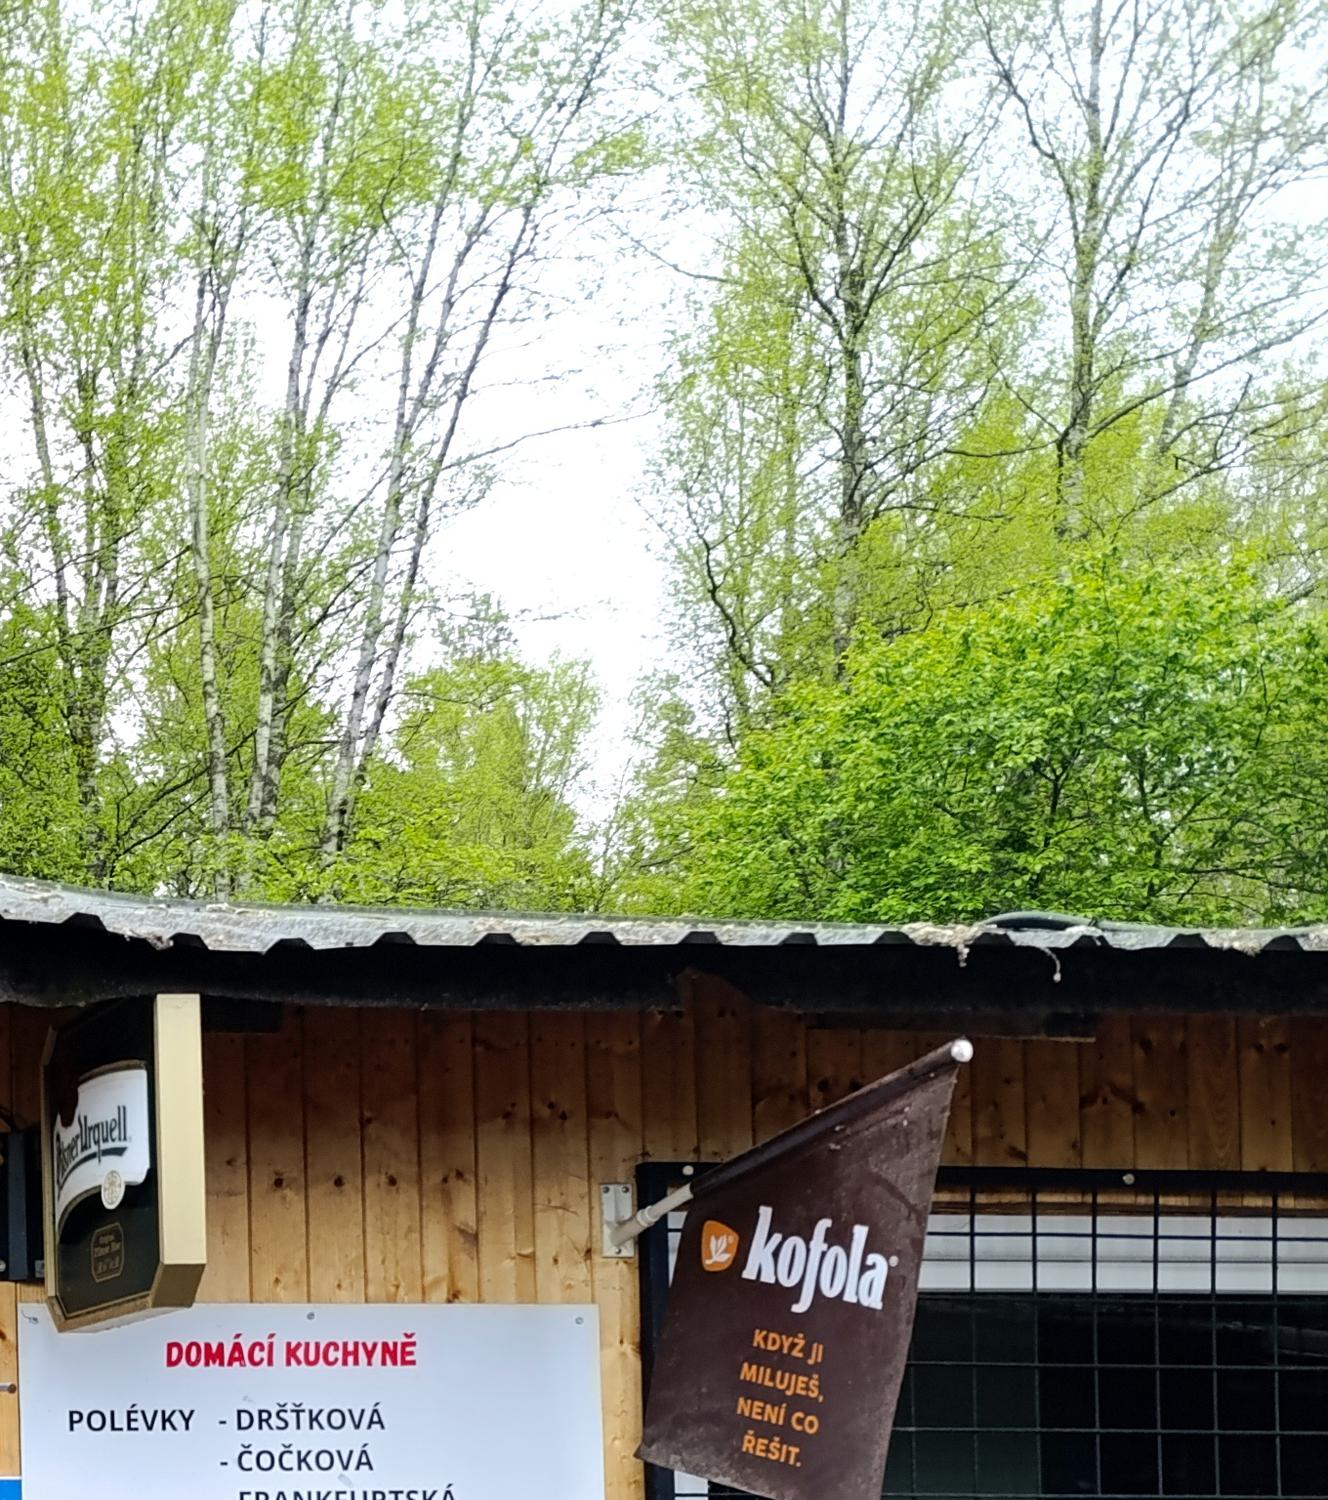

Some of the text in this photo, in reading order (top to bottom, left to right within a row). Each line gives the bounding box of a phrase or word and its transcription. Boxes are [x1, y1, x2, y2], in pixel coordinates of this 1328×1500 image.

[77, 1105, 128, 1164] Urquell
[741, 1205, 890, 1314] kofola
[165, 1332, 418, 1368] DOMÁCÍ KUCHYNĚ
[752, 1328, 824, 1363] KDYŽ JI
[739, 1361, 826, 1403] MILUJEŠ,
[68, 1401, 385, 1432] POLÉVKY DRŠŤKOVÁ
[737, 1396, 819, 1434] NENÍ CO
[236, 1442, 374, 1472] ČOČKOVÁ
[742, 1434, 803, 1468] ŘEŠIT.
